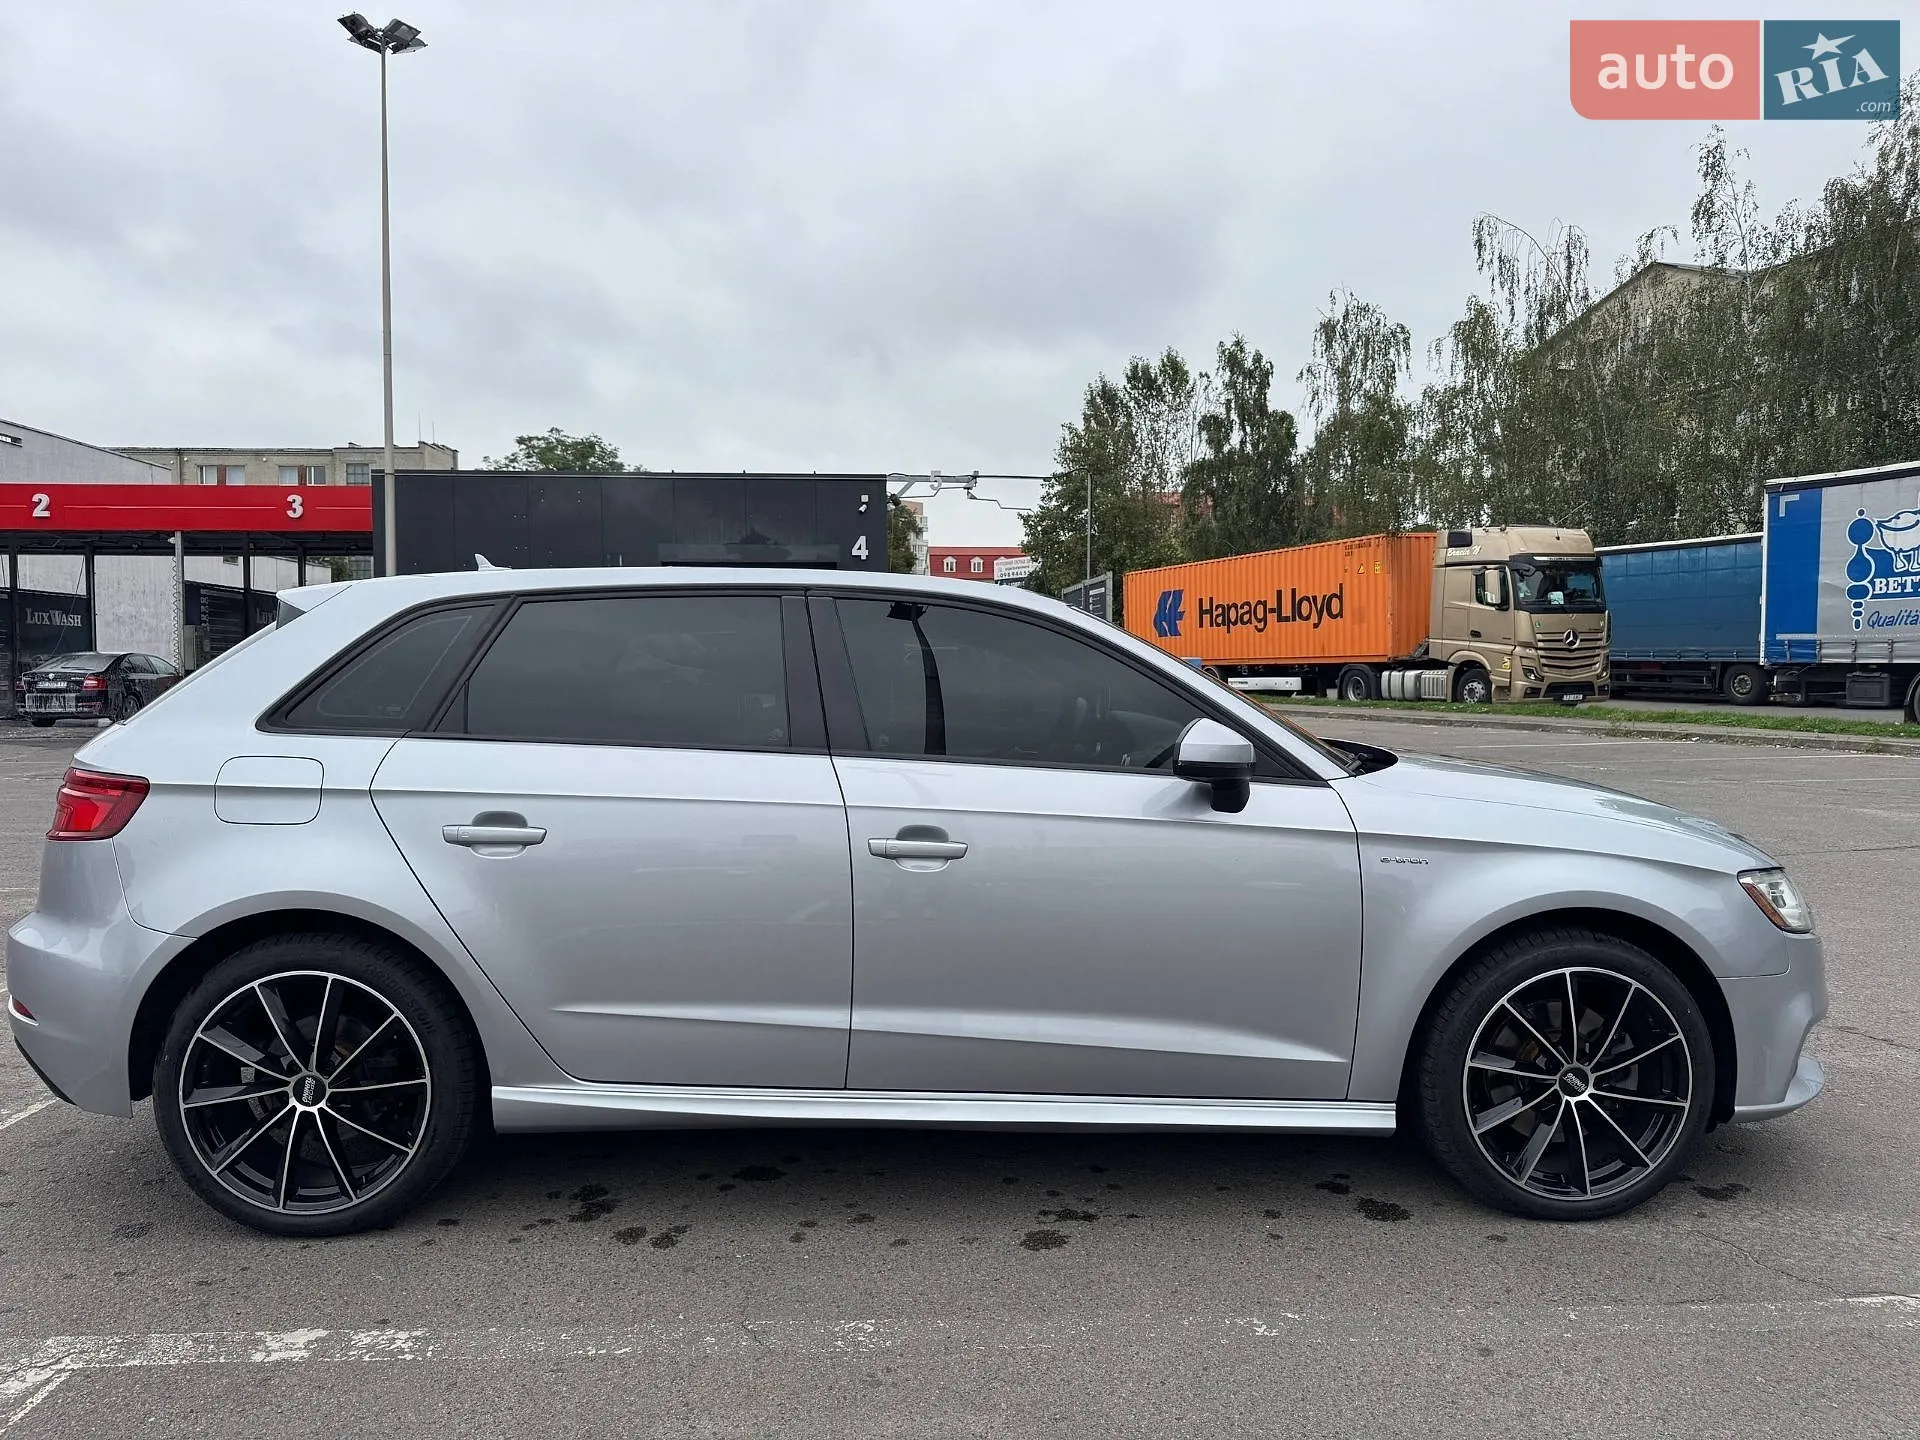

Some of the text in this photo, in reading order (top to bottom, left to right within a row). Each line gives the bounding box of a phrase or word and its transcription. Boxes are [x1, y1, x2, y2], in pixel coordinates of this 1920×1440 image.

[929, 470, 943, 491] 5
[31, 493, 51, 518] 2
[286, 494, 304, 519] 3
[851, 535, 869, 561] 4
[1198, 583, 1344, 634] Hapag-Lloyd
[1380, 856, 1429, 865] e-tron
